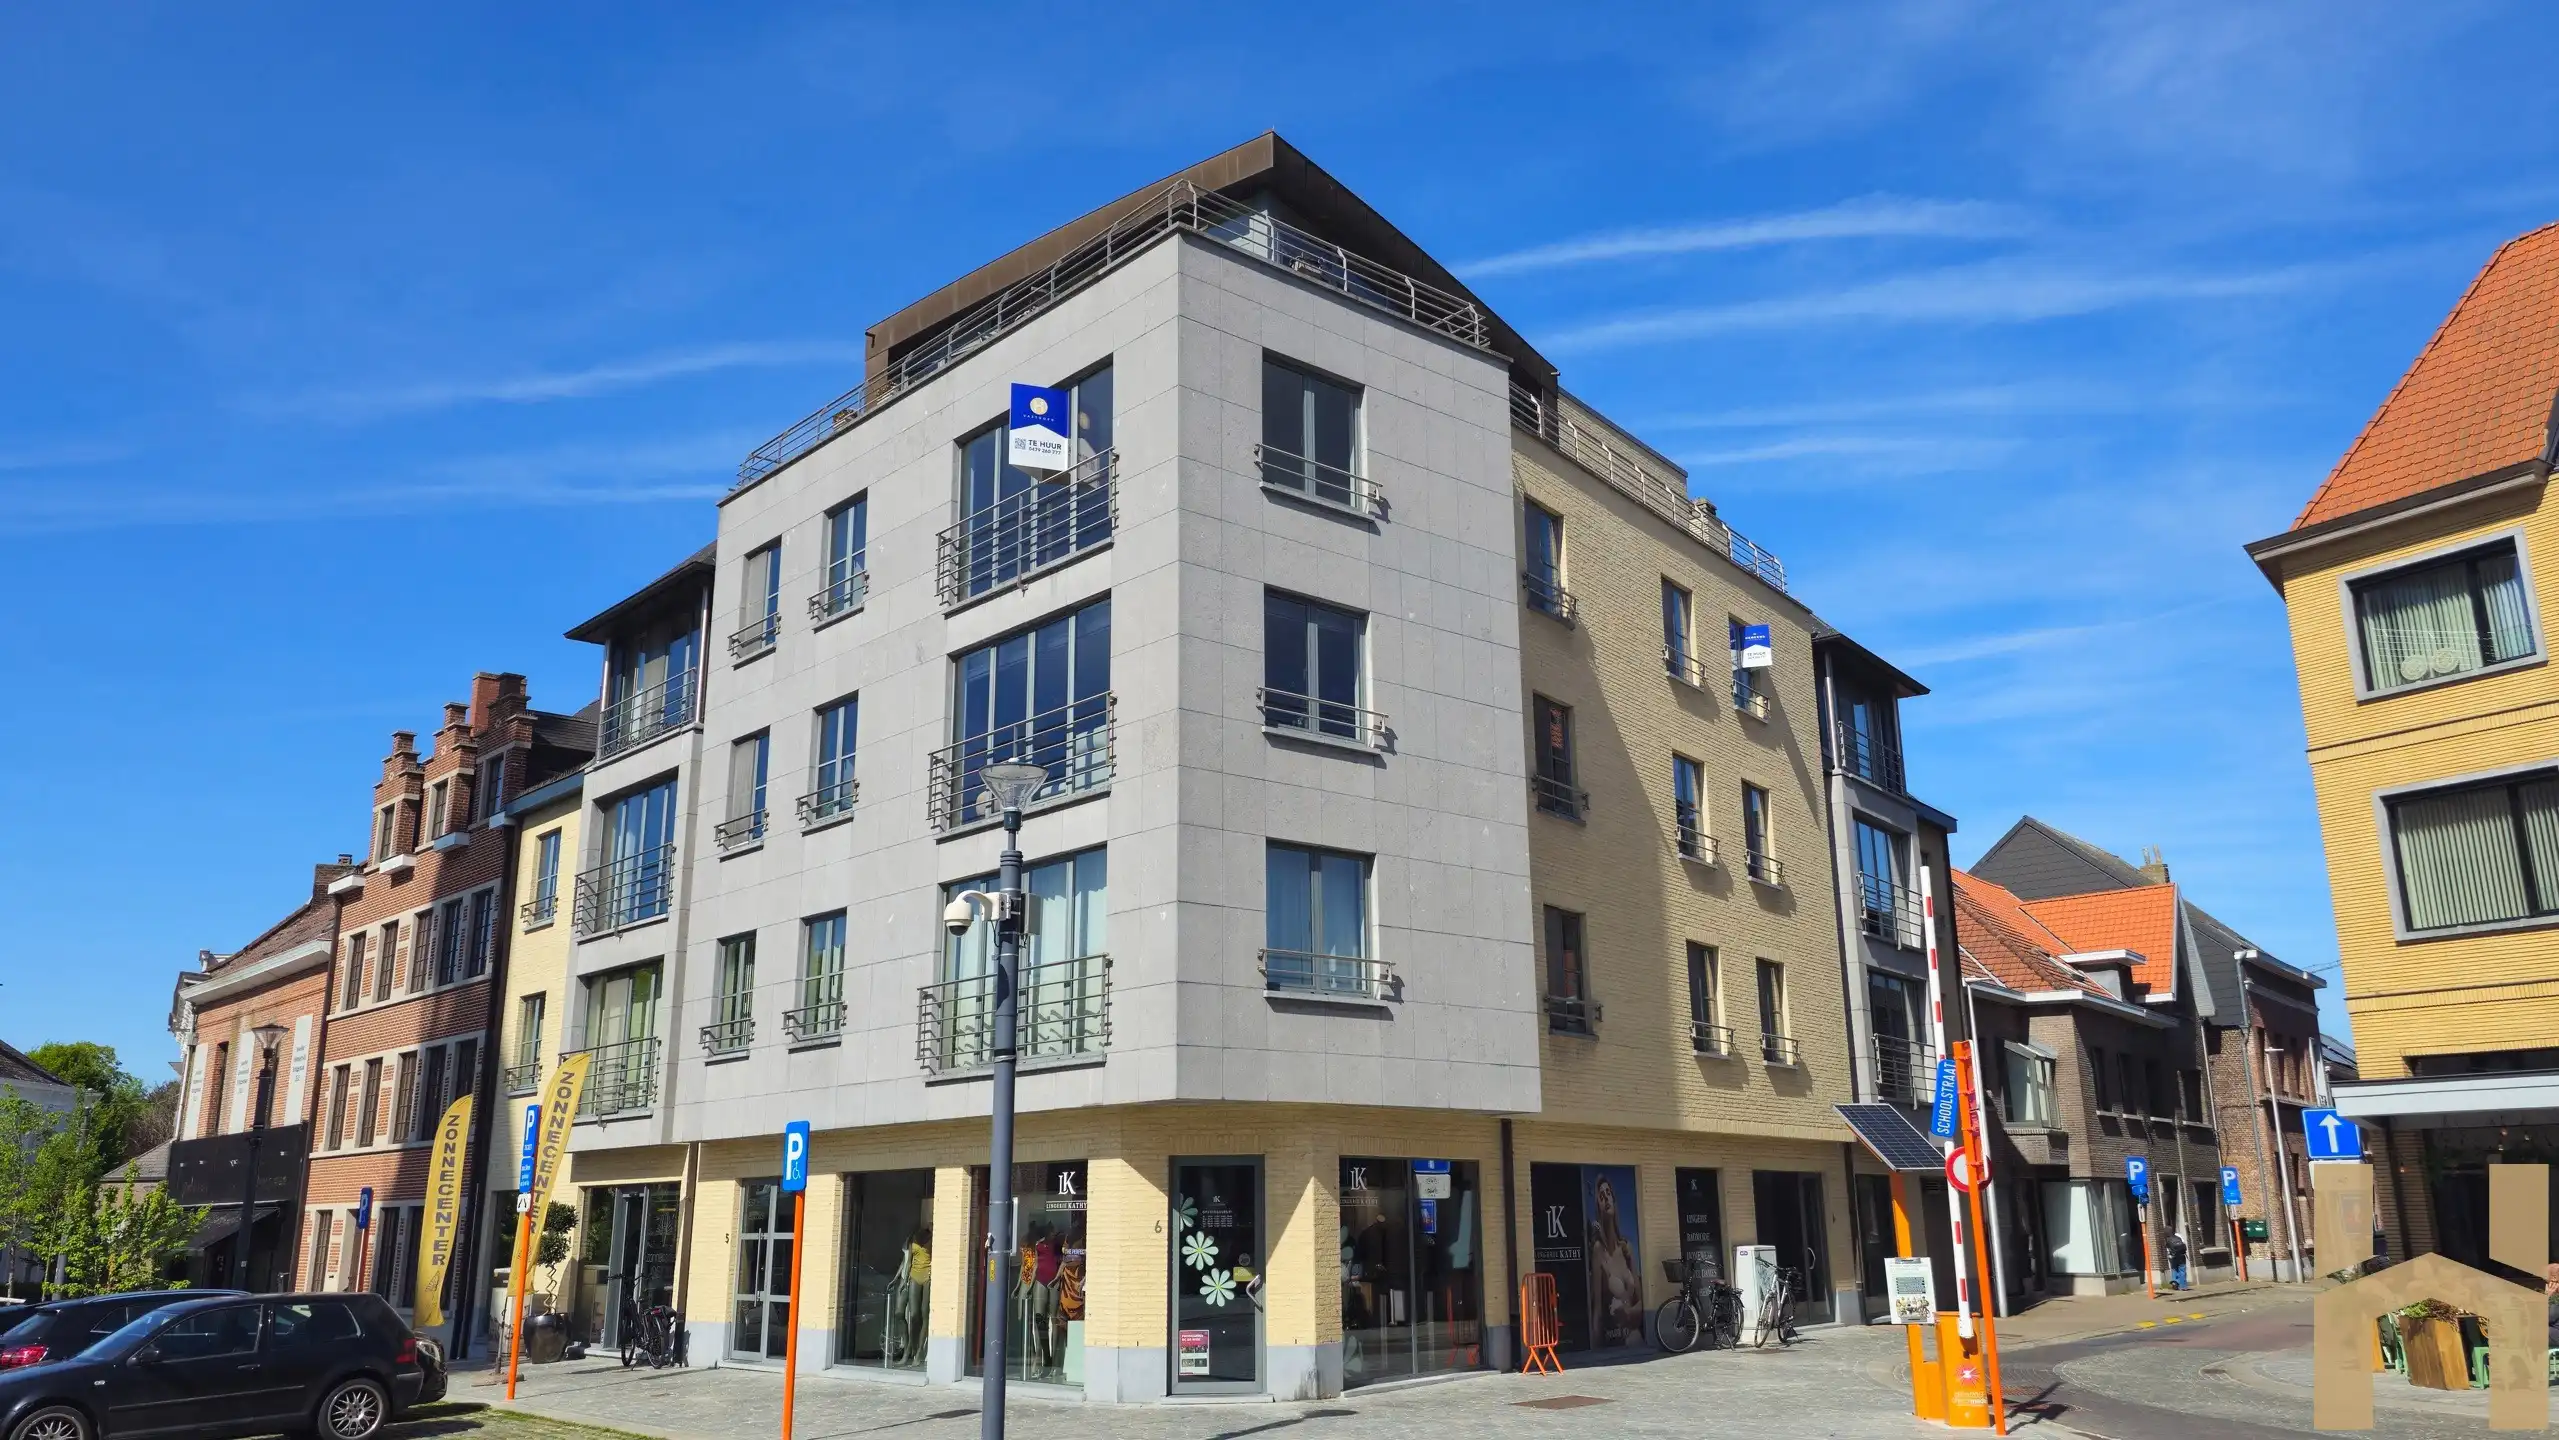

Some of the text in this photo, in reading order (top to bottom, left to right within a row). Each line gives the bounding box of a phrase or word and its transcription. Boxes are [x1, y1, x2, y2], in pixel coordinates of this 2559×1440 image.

[1028, 439, 1062, 450] TE HUUR
[1937, 1061, 1957, 1135] SCHOOLSTRAAT
[525, 1109, 535, 1141] P
[530, 1071, 575, 1234] ZONNECENTER
[785, 1132, 803, 1181] P
[1058, 1171, 1077, 1195] LK
[2128, 1161, 2144, 1181] P
[2222, 1170, 2237, 1187] P
[431, 1114, 460, 1266] ZONNECENTER
[359, 1193, 368, 1223] P
[1546, 1205, 1567, 1238] LK
[724, 1233, 730, 1244] 5
[1155, 1219, 1162, 1234] 6
[1559, 1249, 1581, 1258] KATHY
